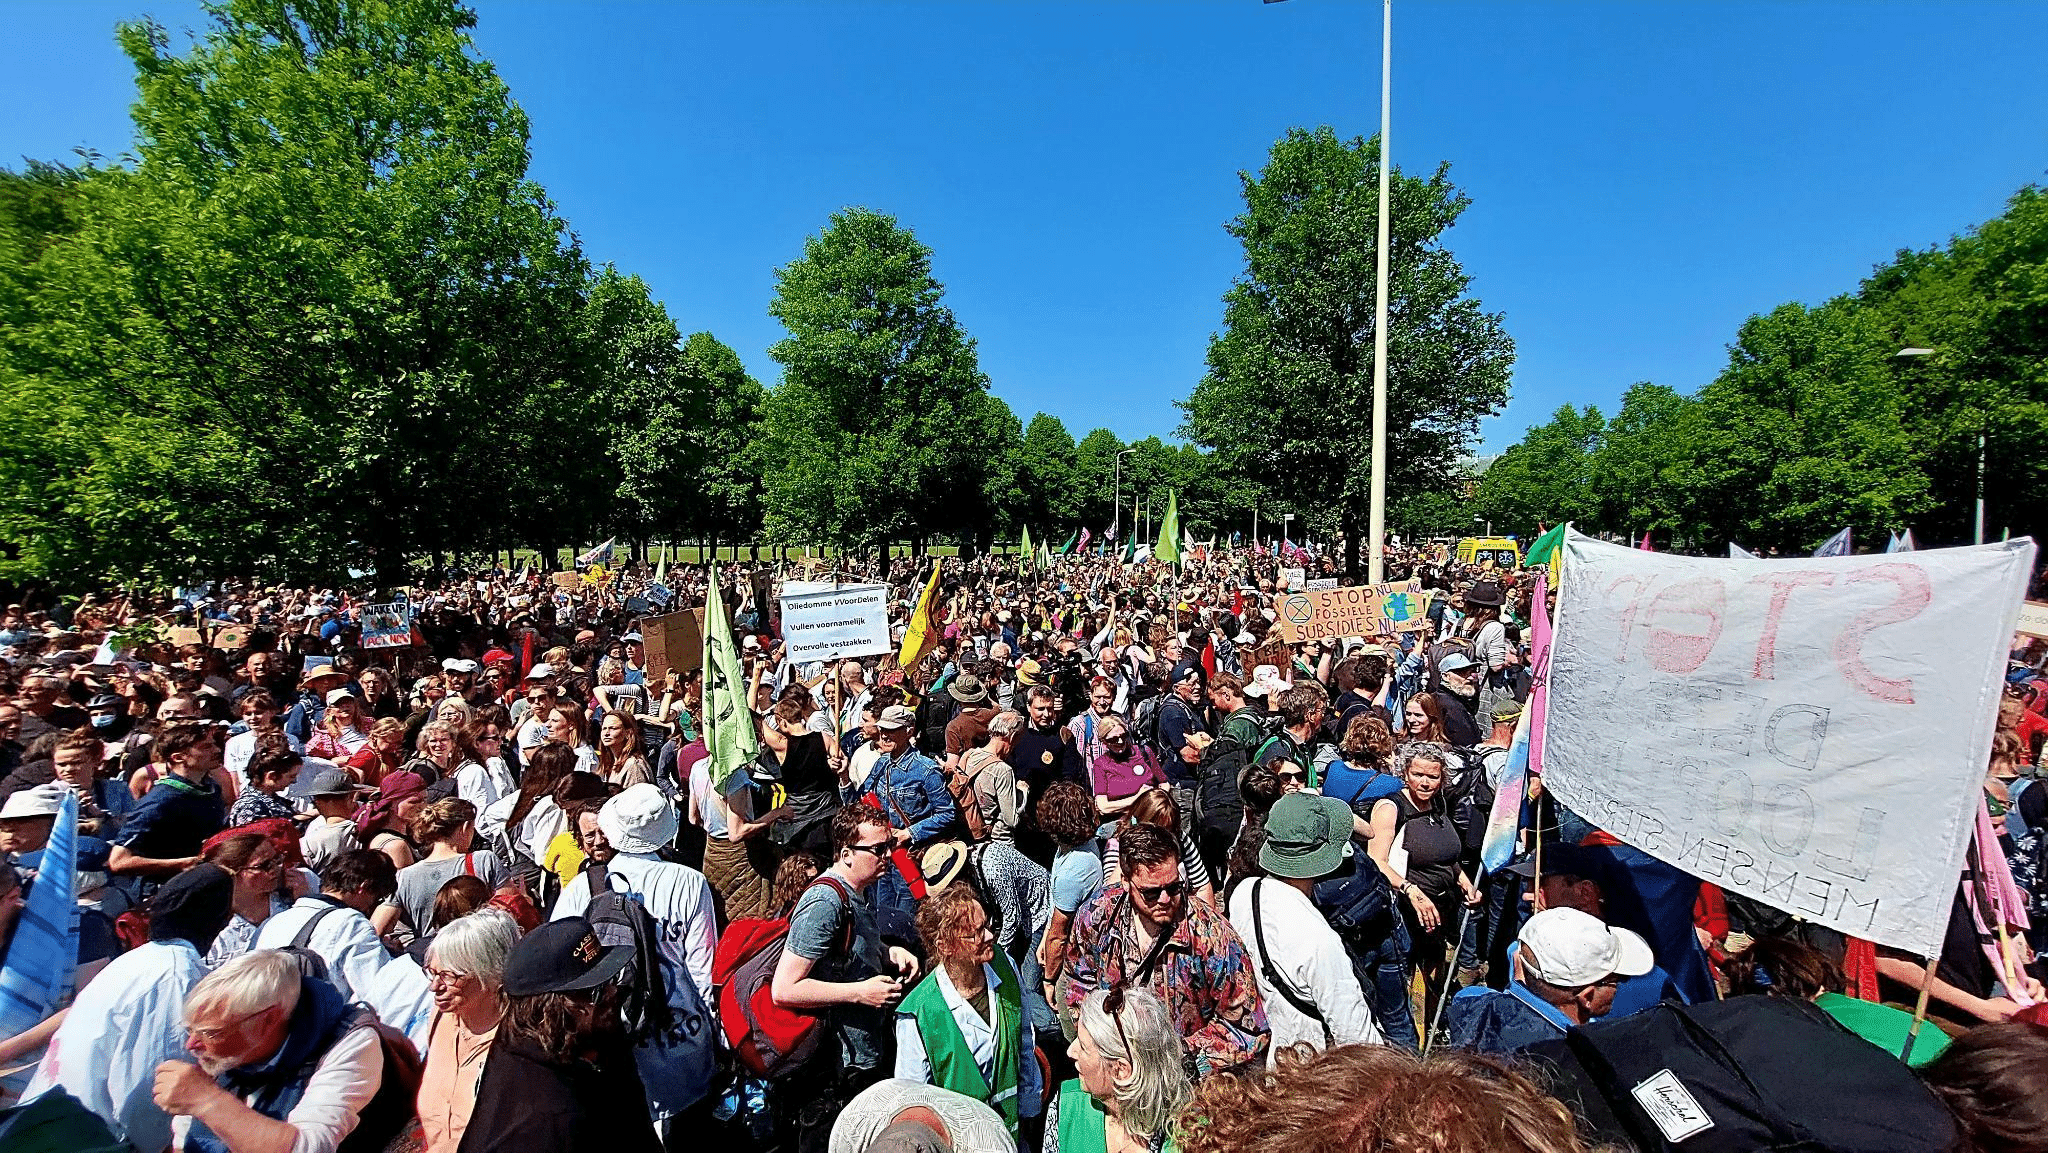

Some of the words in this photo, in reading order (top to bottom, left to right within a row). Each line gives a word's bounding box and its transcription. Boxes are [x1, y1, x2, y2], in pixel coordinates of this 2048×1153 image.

[1321, 588, 1374, 608] STOP
[1375, 583, 1392, 598] NU
[1406, 582, 1421, 594] NU
[363, 605, 391, 616] WAKE
[391, 603, 406, 613] UP
[788, 601, 832, 610] Oliedomme
[1315, 605, 1373, 620] FOSSIELE
[790, 622, 815, 631] Vullen
[816, 617, 866, 630] voornamelijk
[1296, 616, 1376, 641] SUBSIDIES
[792, 641, 829, 652] Overvolle
[830, 637, 872, 648] vestzakken
[1653, 1085, 1698, 1124] Herschel
